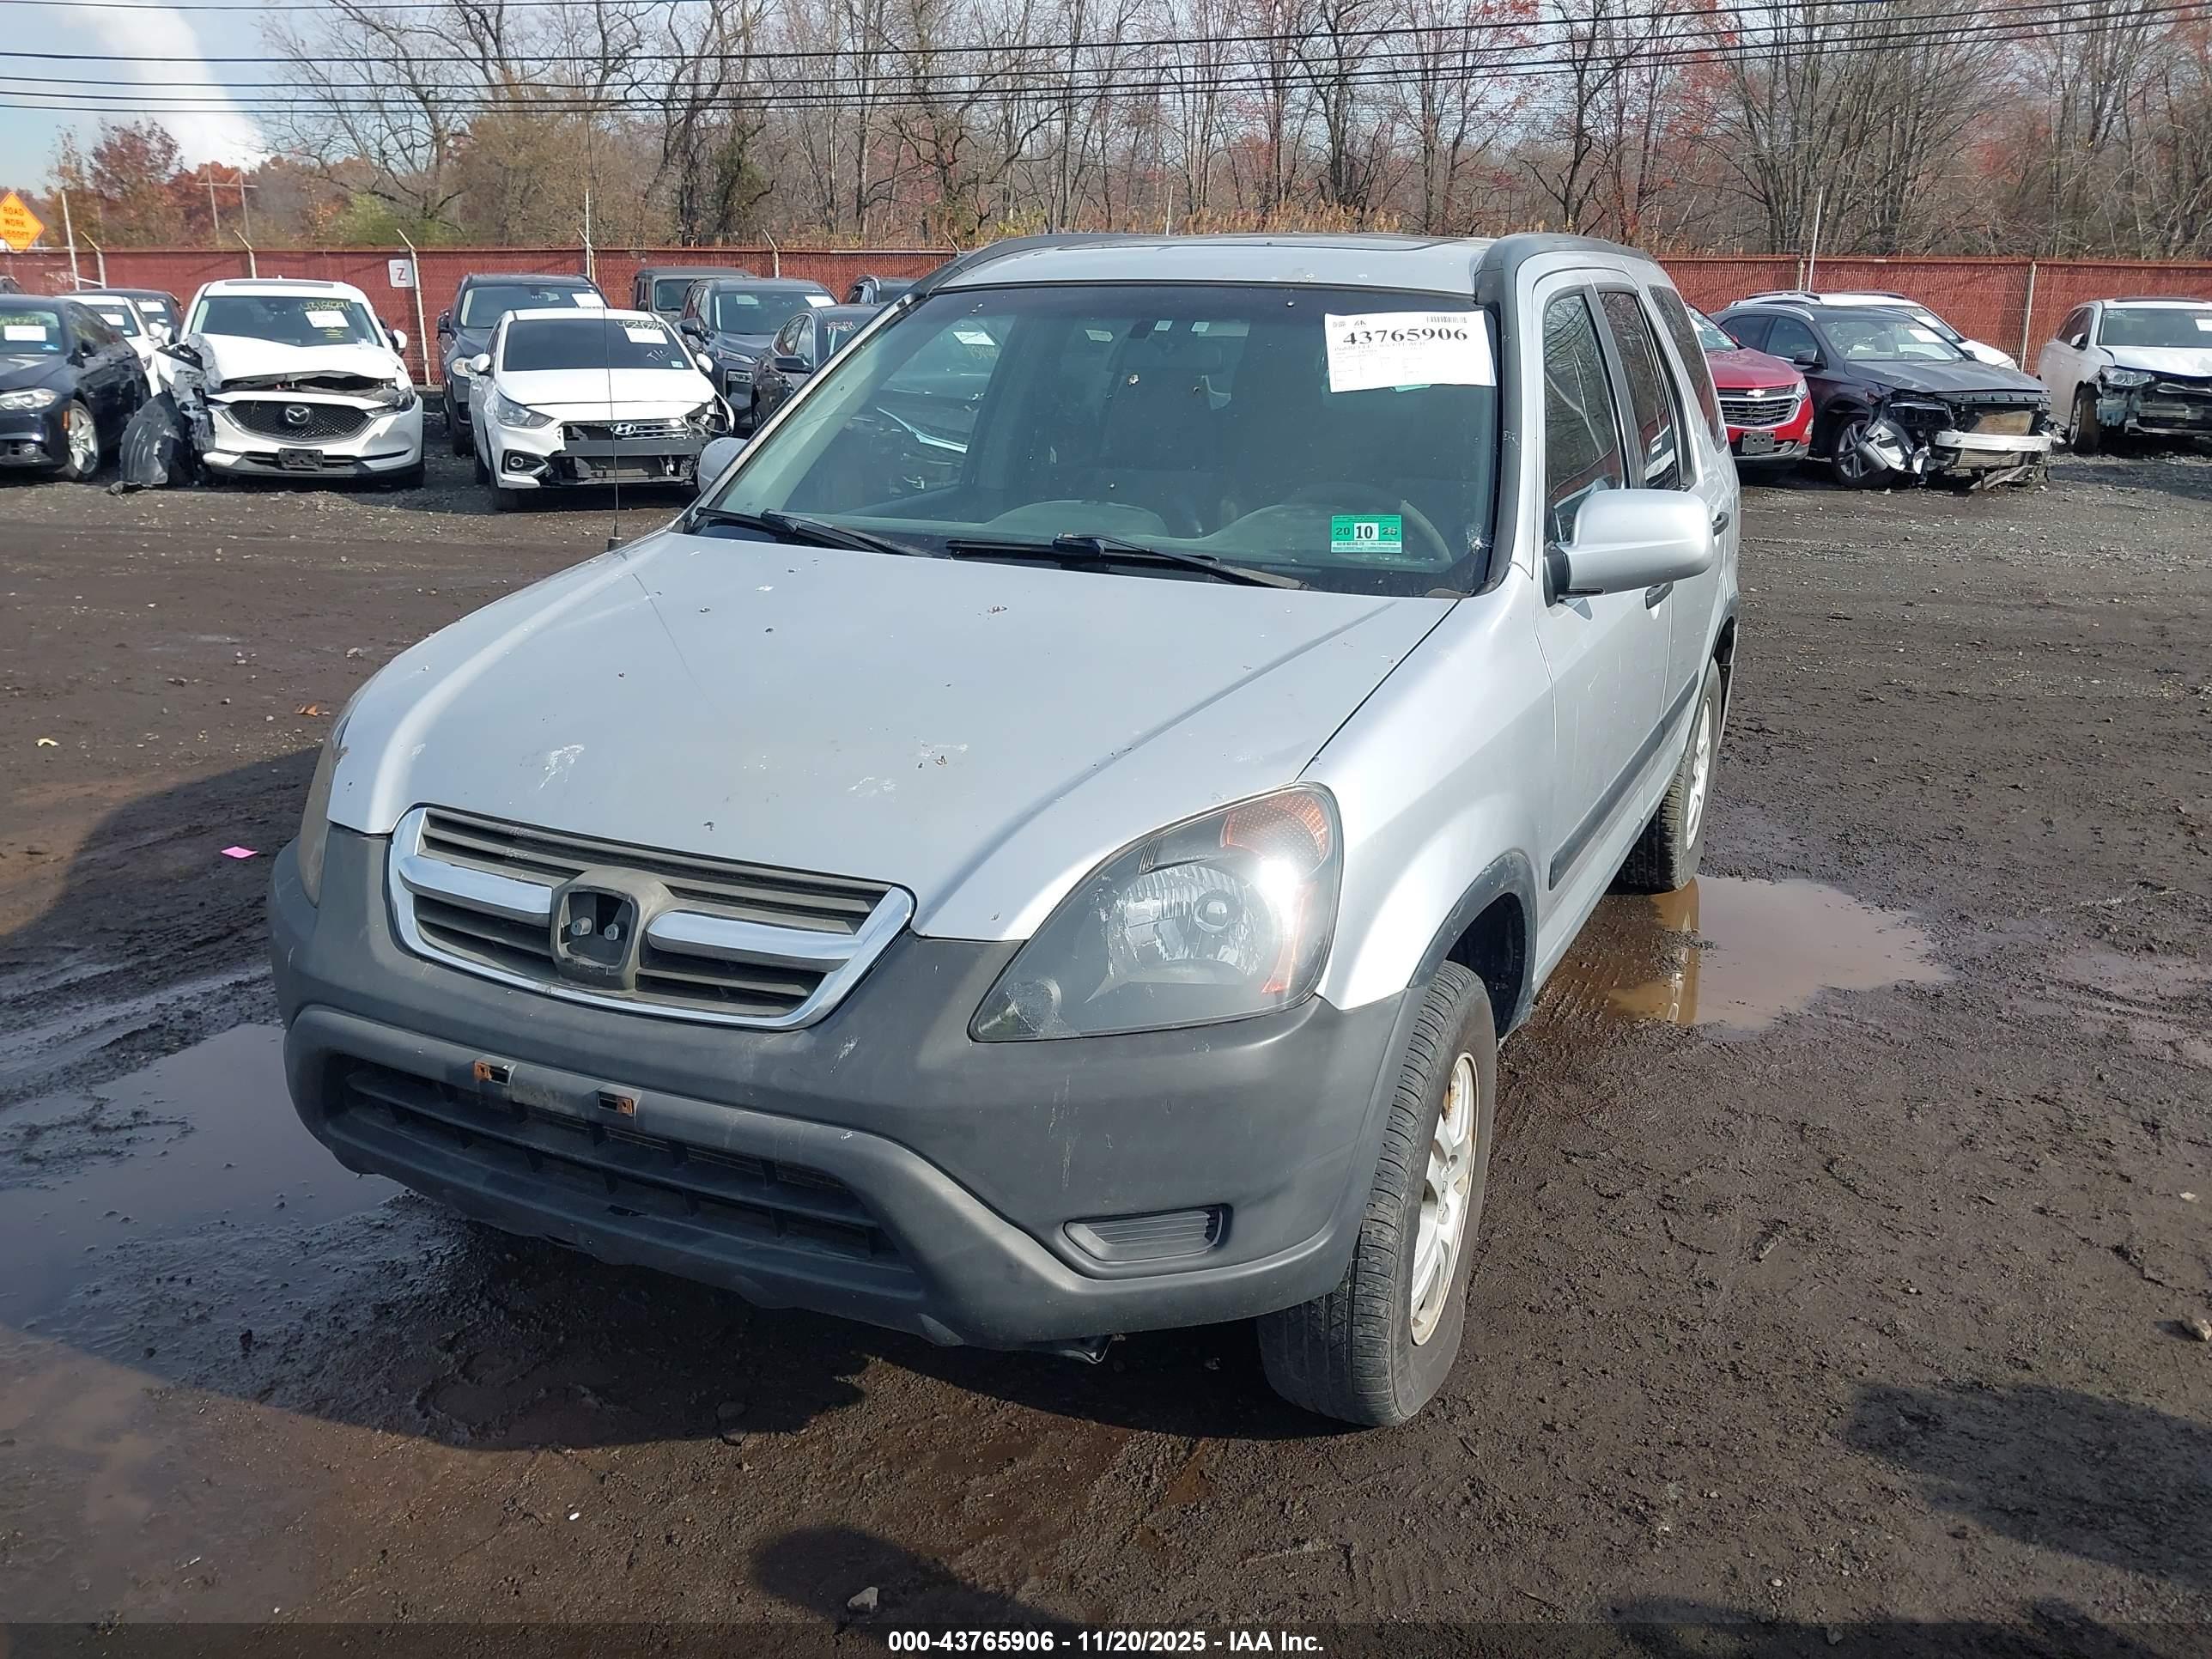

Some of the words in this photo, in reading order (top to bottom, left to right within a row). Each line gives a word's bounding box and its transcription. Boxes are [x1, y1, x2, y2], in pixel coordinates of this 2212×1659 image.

[397, 267, 406, 281] Z
[1342, 327, 1468, 345] 43765906
[1335, 526, 1351, 536] 20
[1356, 526, 1374, 539] 10
